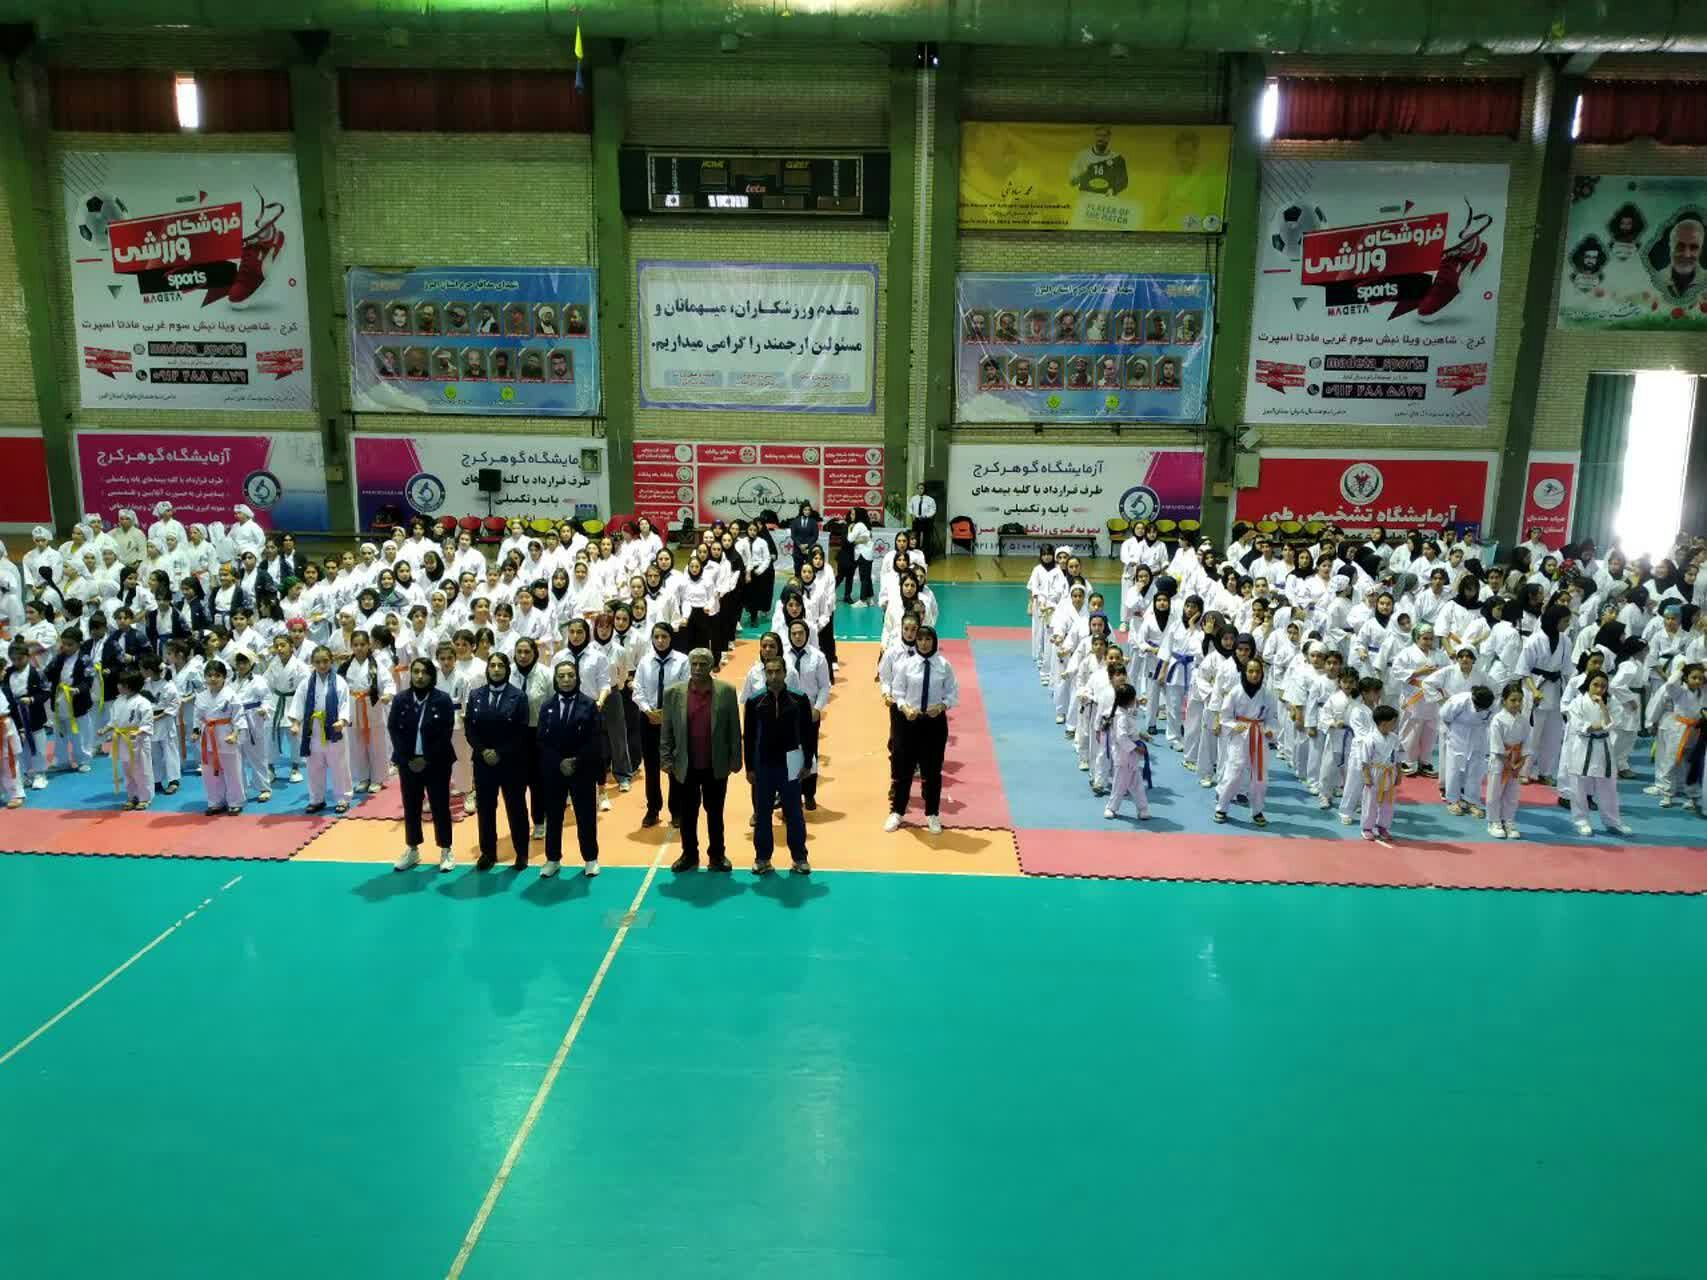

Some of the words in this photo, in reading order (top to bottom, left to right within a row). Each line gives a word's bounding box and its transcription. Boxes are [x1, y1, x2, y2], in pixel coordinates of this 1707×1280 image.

[113, 231, 192, 264] ورزشی
[1304, 241, 1387, 275] ورزشی
[167, 269, 208, 290] sports
[1357, 282, 1399, 303] sports
[653, 304, 662, 317] و
[817, 301, 859, 317] مقدم
[280, 321, 299, 335] کرج
[706, 334, 746, 354] گرامی
[750, 336, 760, 354] را
[763, 336, 809, 355] ارجمند
[1466, 335, 1486, 350] کرج
[96, 448, 124, 465] کرج
[125, 447, 165, 464] گوهر
[166, 447, 232, 465] آزمایشگاه
[461, 451, 487, 467] کرج
[488, 449, 526, 466] گوهر
[528, 450, 582, 468] مایشگاه
[973, 461, 999, 478] کرج
[1000, 460, 1039, 476] گوهر
[1041, 460, 1104, 477] آزمایشگاه
[567, 476, 591, 488] طرف
[1013, 485, 1031, 496] کلیه
[1033, 485, 1041, 496] با
[1043, 484, 1079, 497] قرارداد
[495, 493, 530, 505] تکمیلی
[1080, 485, 1103, 498] طرف
[1003, 504, 1040, 516] تکمیلی
[1048, 504, 1069, 517] پایه
[1299, 504, 1373, 525] تشخیص
[1376, 505, 1458, 526] آزمایشگاه
